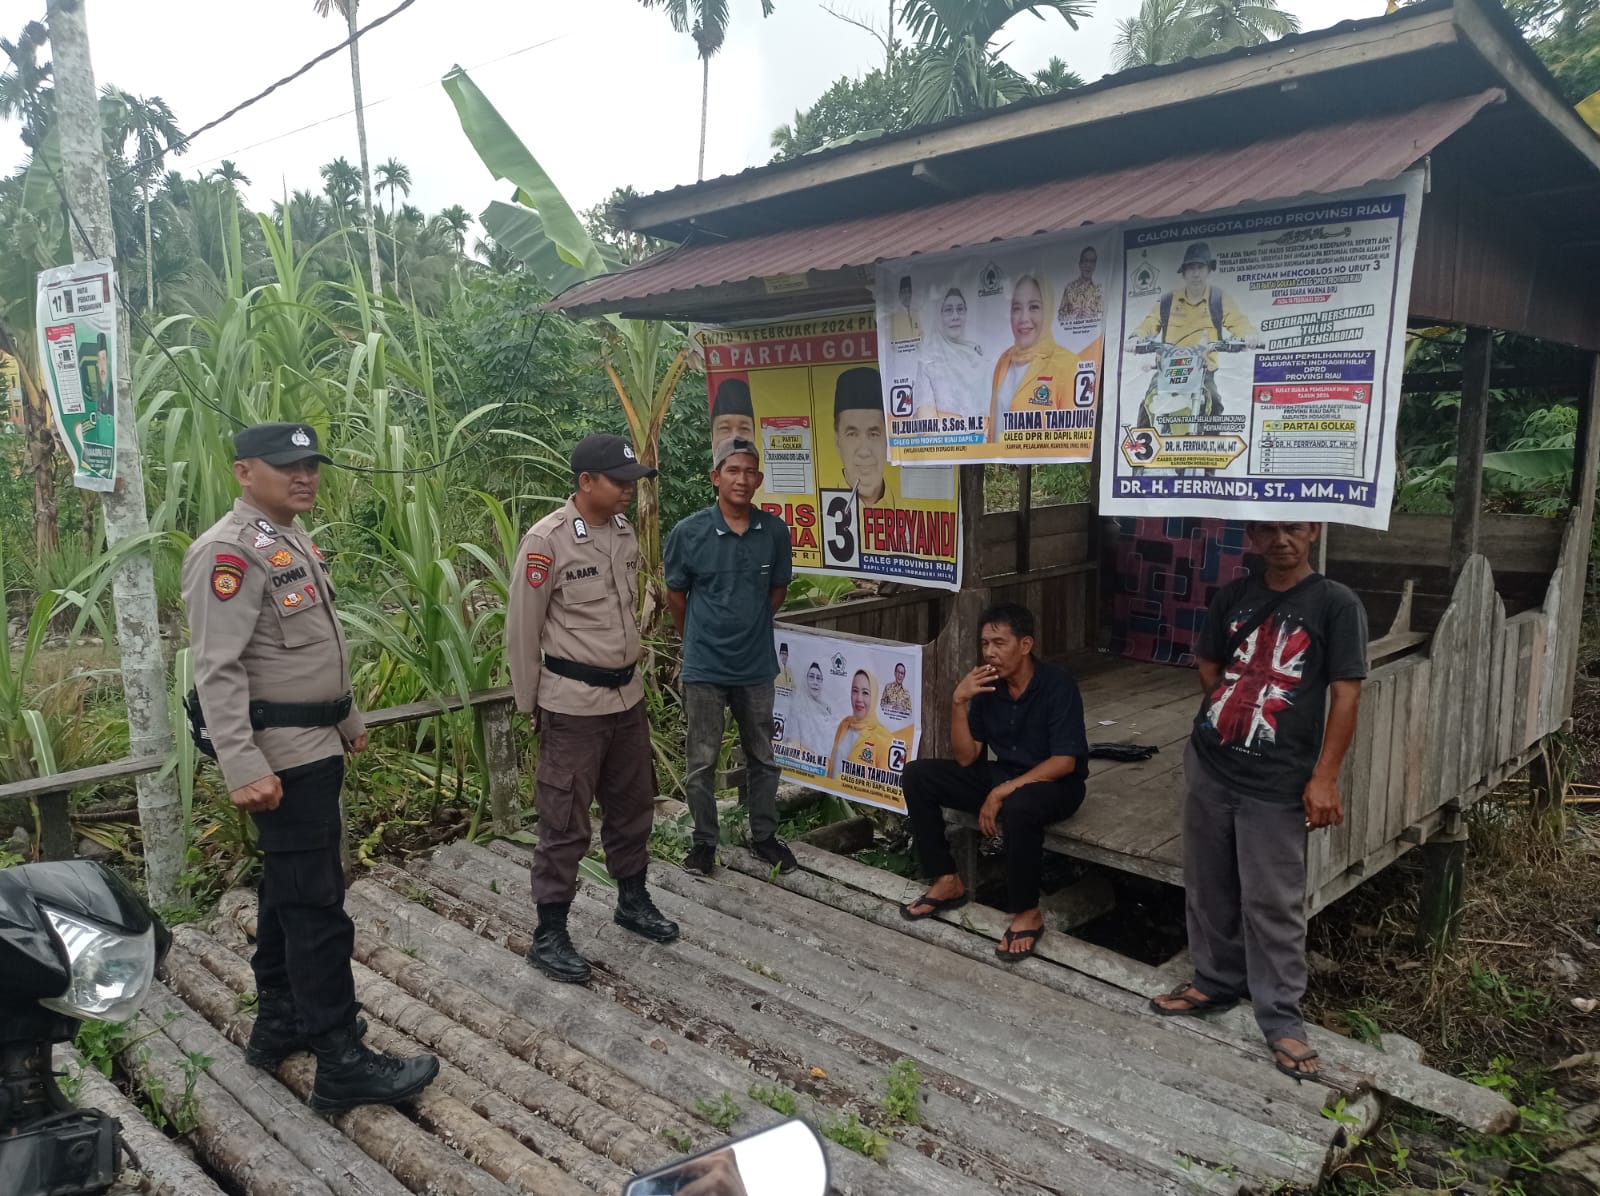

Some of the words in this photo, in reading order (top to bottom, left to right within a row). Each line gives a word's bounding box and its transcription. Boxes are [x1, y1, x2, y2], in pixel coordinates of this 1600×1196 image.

[1137, 228, 1178, 243] CALON
[1182, 220, 1243, 237] ANGGOTA
[1245, 214, 1282, 229] DPRD
[1286, 207, 1352, 224] PROVINSI
[1356, 202, 1392, 216] RIAU
[1237, 271, 1278, 282] BERKENAN
[1280, 266, 1333, 278] MENCOBLOS
[1334, 266, 1346, 274] NO
[1348, 264, 1371, 272] URUT
[1373, 260, 1380, 270] 3
[1320, 304, 1374, 320] BERSAHAJA
[754, 322, 817, 340] FEBRUARI
[822, 318, 852, 334] 2024
[1302, 322, 1334, 336] TULUS
[1270, 336, 1302, 350] DALAM
[1304, 328, 1363, 346] PENGABDIAN
[730, 343, 812, 367] PARTAI
[1259, 354, 1294, 362] DAERAH
[1344, 352, 1364, 360] RIAU
[1262, 360, 1307, 368] KABUPATEN
[1165, 368, 1194, 378] FERRY
[1286, 373, 1324, 381] PROVINSI
[1324, 372, 1342, 380] RIAU
[1304, 366, 1327, 374] DPRD
[1080, 376, 1090, 402] 2
[896, 390, 907, 412] 2
[942, 418, 967, 432] S.Sos,
[968, 416, 984, 430] M.E
[1004, 412, 1042, 430] TRIANA
[1045, 409, 1094, 429] TANDJUNG
[1283, 422, 1318, 430] PARTAI
[1320, 422, 1355, 430] GOLKAR
[770, 438, 776, 448] 4
[1004, 432, 1024, 442] CALEG
[1026, 432, 1042, 441] DPR
[1044, 432, 1052, 440] RI
[1054, 432, 1072, 440] DAPIL
[1074, 432, 1087, 440] RIAU
[1088, 430, 1092, 440] 2
[1134, 432, 1154, 460] 3
[1165, 440, 1175, 452] DR.
[1176, 441, 1182, 452] H.
[1182, 441, 1209, 453] FERRYANDI,
[1120, 480, 1146, 494] DR.
[1152, 480, 1168, 494] H.
[1174, 480, 1259, 500] FERRYANDI,
[1264, 483, 1295, 500] ST.,
[1301, 483, 1344, 502] MM.,
[1348, 485, 1368, 502] MT
[826, 496, 854, 562] 3
[863, 508, 956, 558] FERRYANDI
[864, 556, 892, 565] CALEG
[894, 558, 933, 570] PROVINSI
[566, 571, 576, 581] M.
[576, 566, 600, 579] RAFIK
[892, 750, 902, 768] 2
[842, 760, 866, 779] TRIANA
[840, 774, 854, 784] CALEG
[855, 778, 865, 786] DPR
[866, 780, 872, 788] RI
[872, 782, 886, 792] DAPIL
